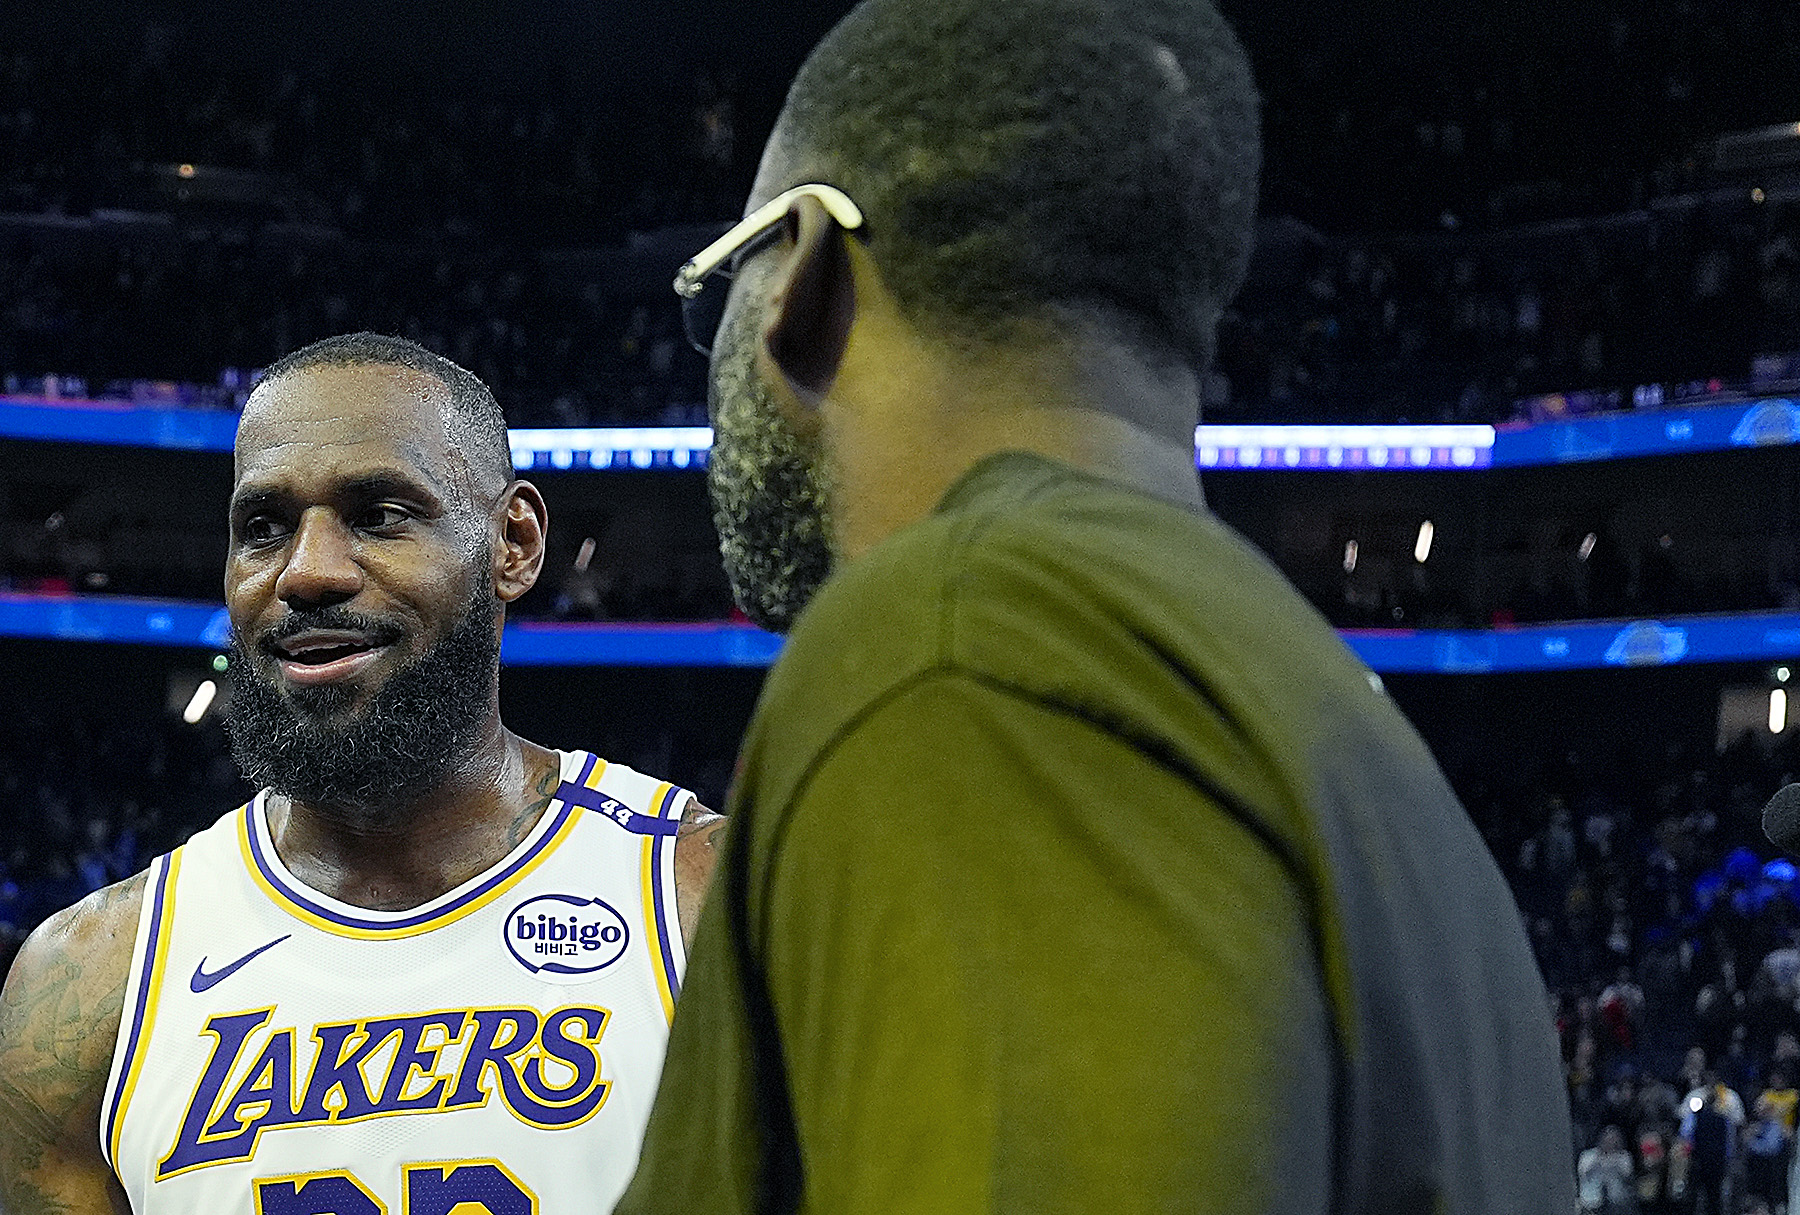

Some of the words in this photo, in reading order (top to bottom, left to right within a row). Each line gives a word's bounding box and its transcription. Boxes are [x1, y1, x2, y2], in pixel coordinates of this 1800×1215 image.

[600, 799, 634, 826] 44
[516, 914, 622, 951] bibigo
[534, 943, 579, 956] 비비고
[155, 1003, 613, 1183] LAKERS
